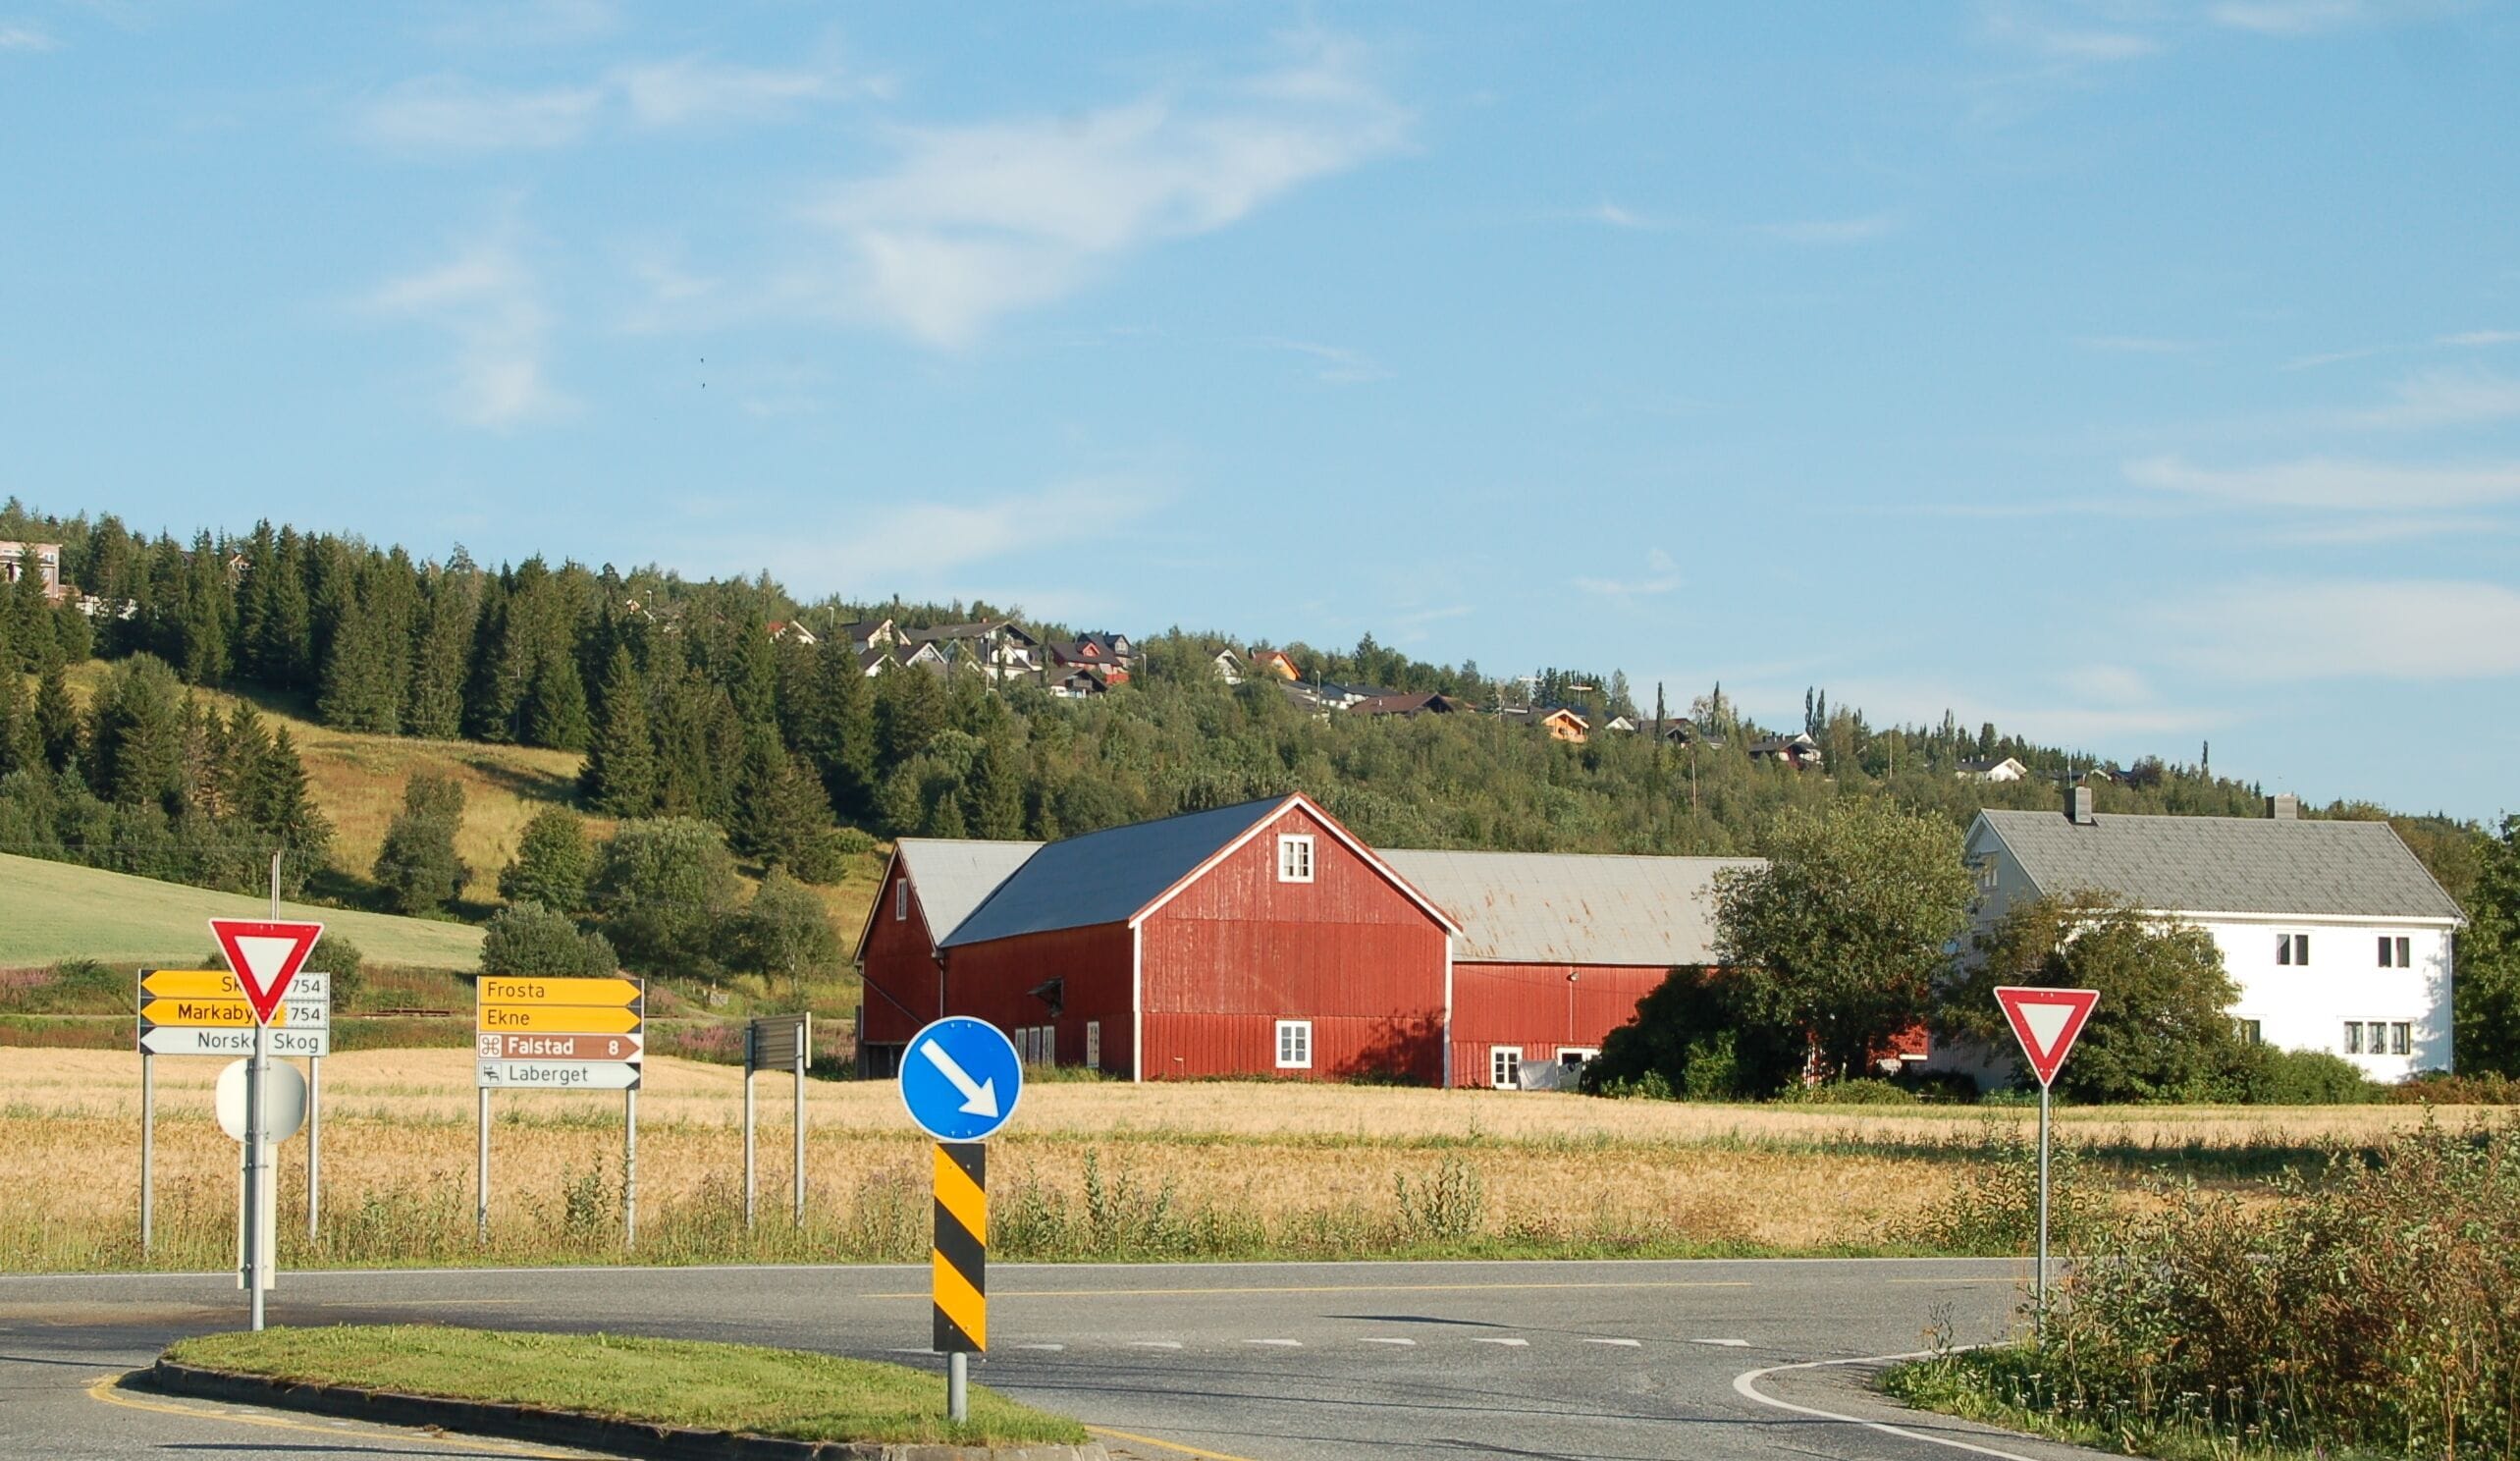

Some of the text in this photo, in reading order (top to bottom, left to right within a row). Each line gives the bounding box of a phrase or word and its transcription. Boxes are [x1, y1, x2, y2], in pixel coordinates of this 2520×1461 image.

[292, 980, 320, 993] 754
[488, 982, 545, 998] Frosta
[178, 1003, 320, 1024] Markaby 754
[488, 1009, 530, 1025] Ekne
[274, 1033, 319, 1053] Skog
[508, 1037, 619, 1055] Falstad 8
[509, 1064, 589, 1085] Laberget
